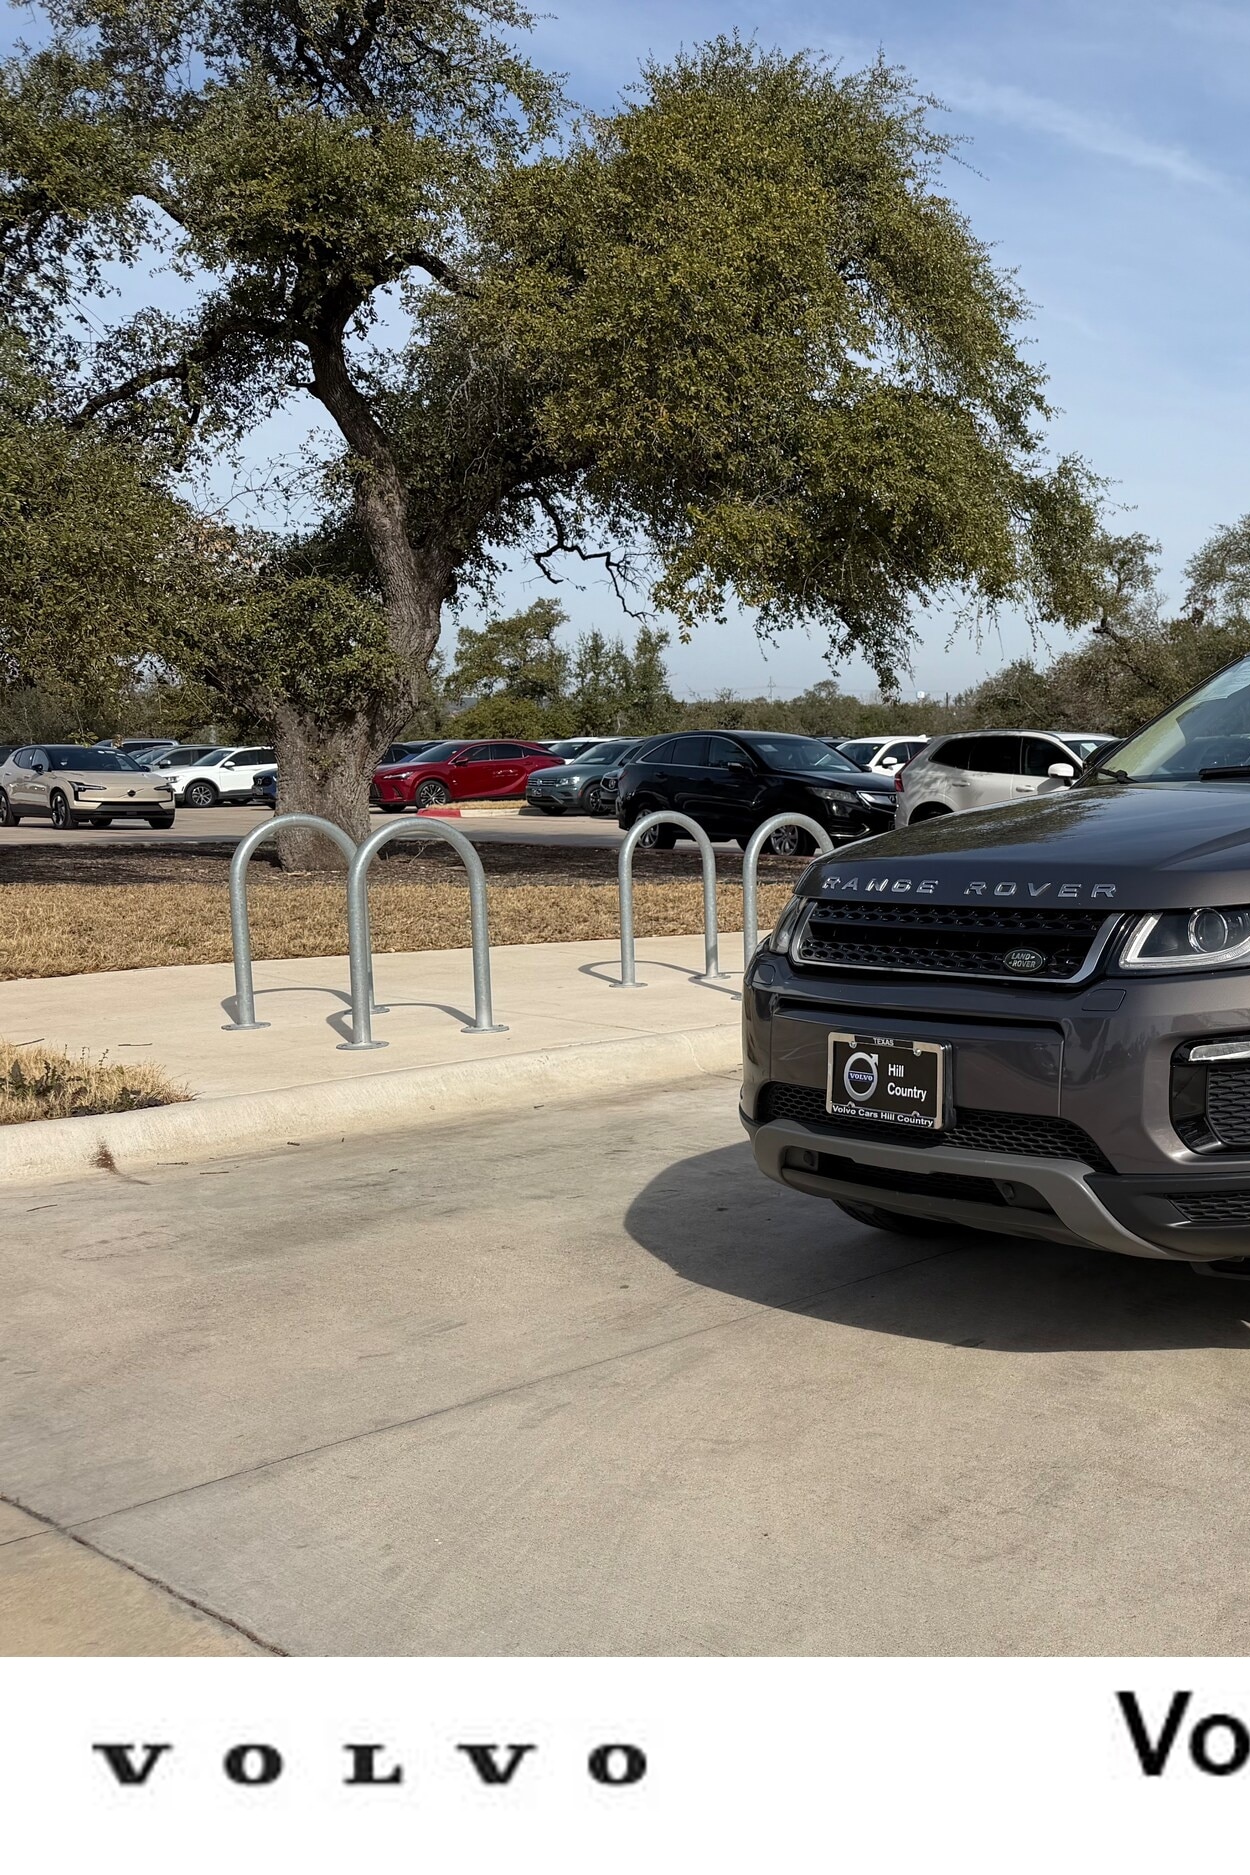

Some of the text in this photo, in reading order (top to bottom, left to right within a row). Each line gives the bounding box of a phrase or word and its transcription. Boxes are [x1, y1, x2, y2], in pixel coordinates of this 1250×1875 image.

[822, 876, 1117, 898] RANGE ROVER
[873, 1037, 894, 1047] TEXAS
[849, 1072, 873, 1081] VOLVO
[888, 1063, 904, 1078] Hill
[887, 1082, 927, 1102] Country
[832, 1104, 934, 1128] Volvo Cars Hill Country
